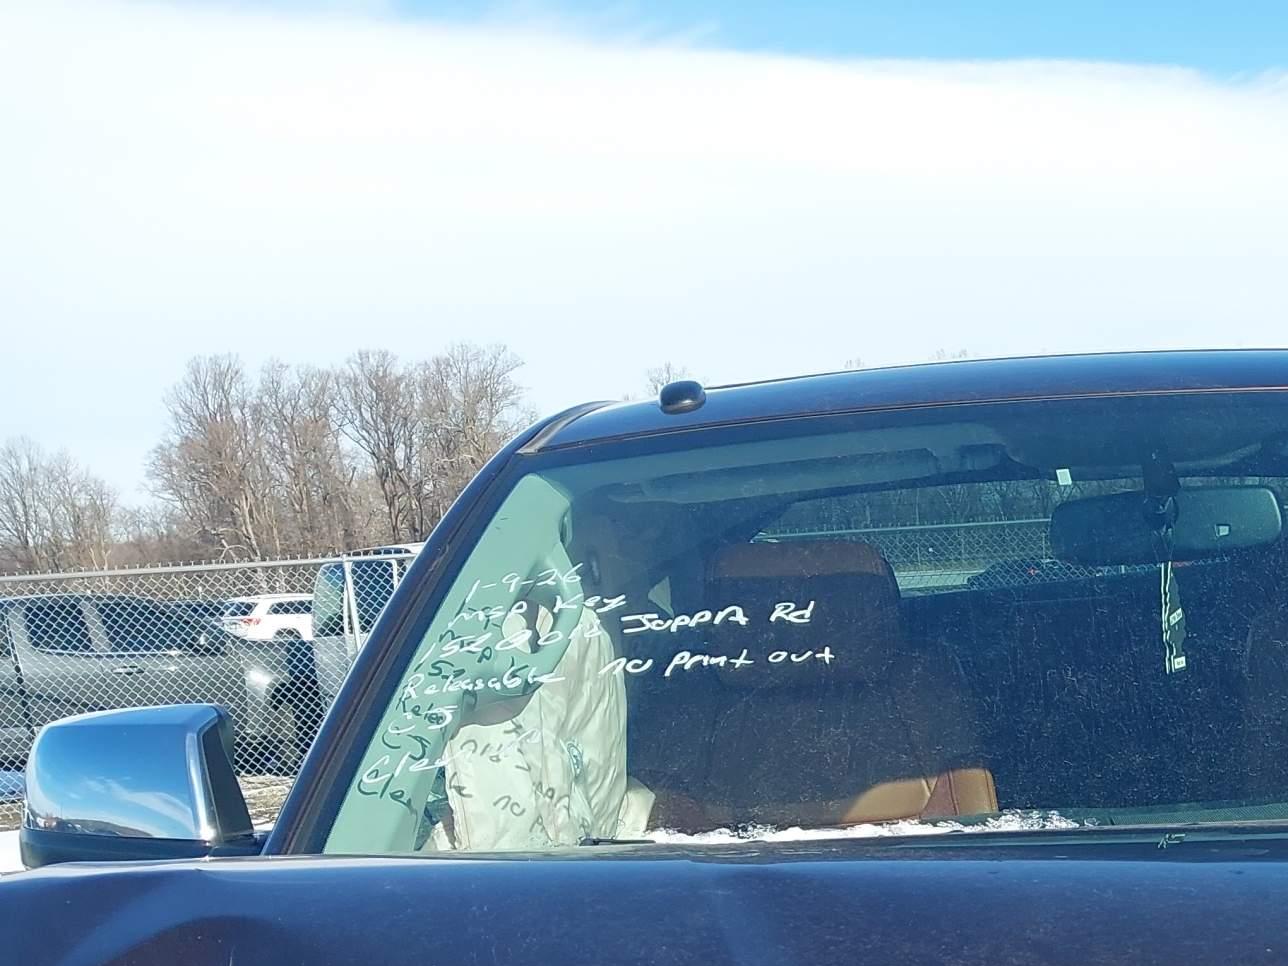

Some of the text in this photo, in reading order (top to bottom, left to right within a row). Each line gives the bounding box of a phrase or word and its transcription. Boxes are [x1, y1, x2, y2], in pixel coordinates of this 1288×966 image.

[465, 562, 584, 603] 1-9-26
[769, 600, 815, 624] Rd
[597, 656, 653, 676] no
[767, 645, 836, 666] out
